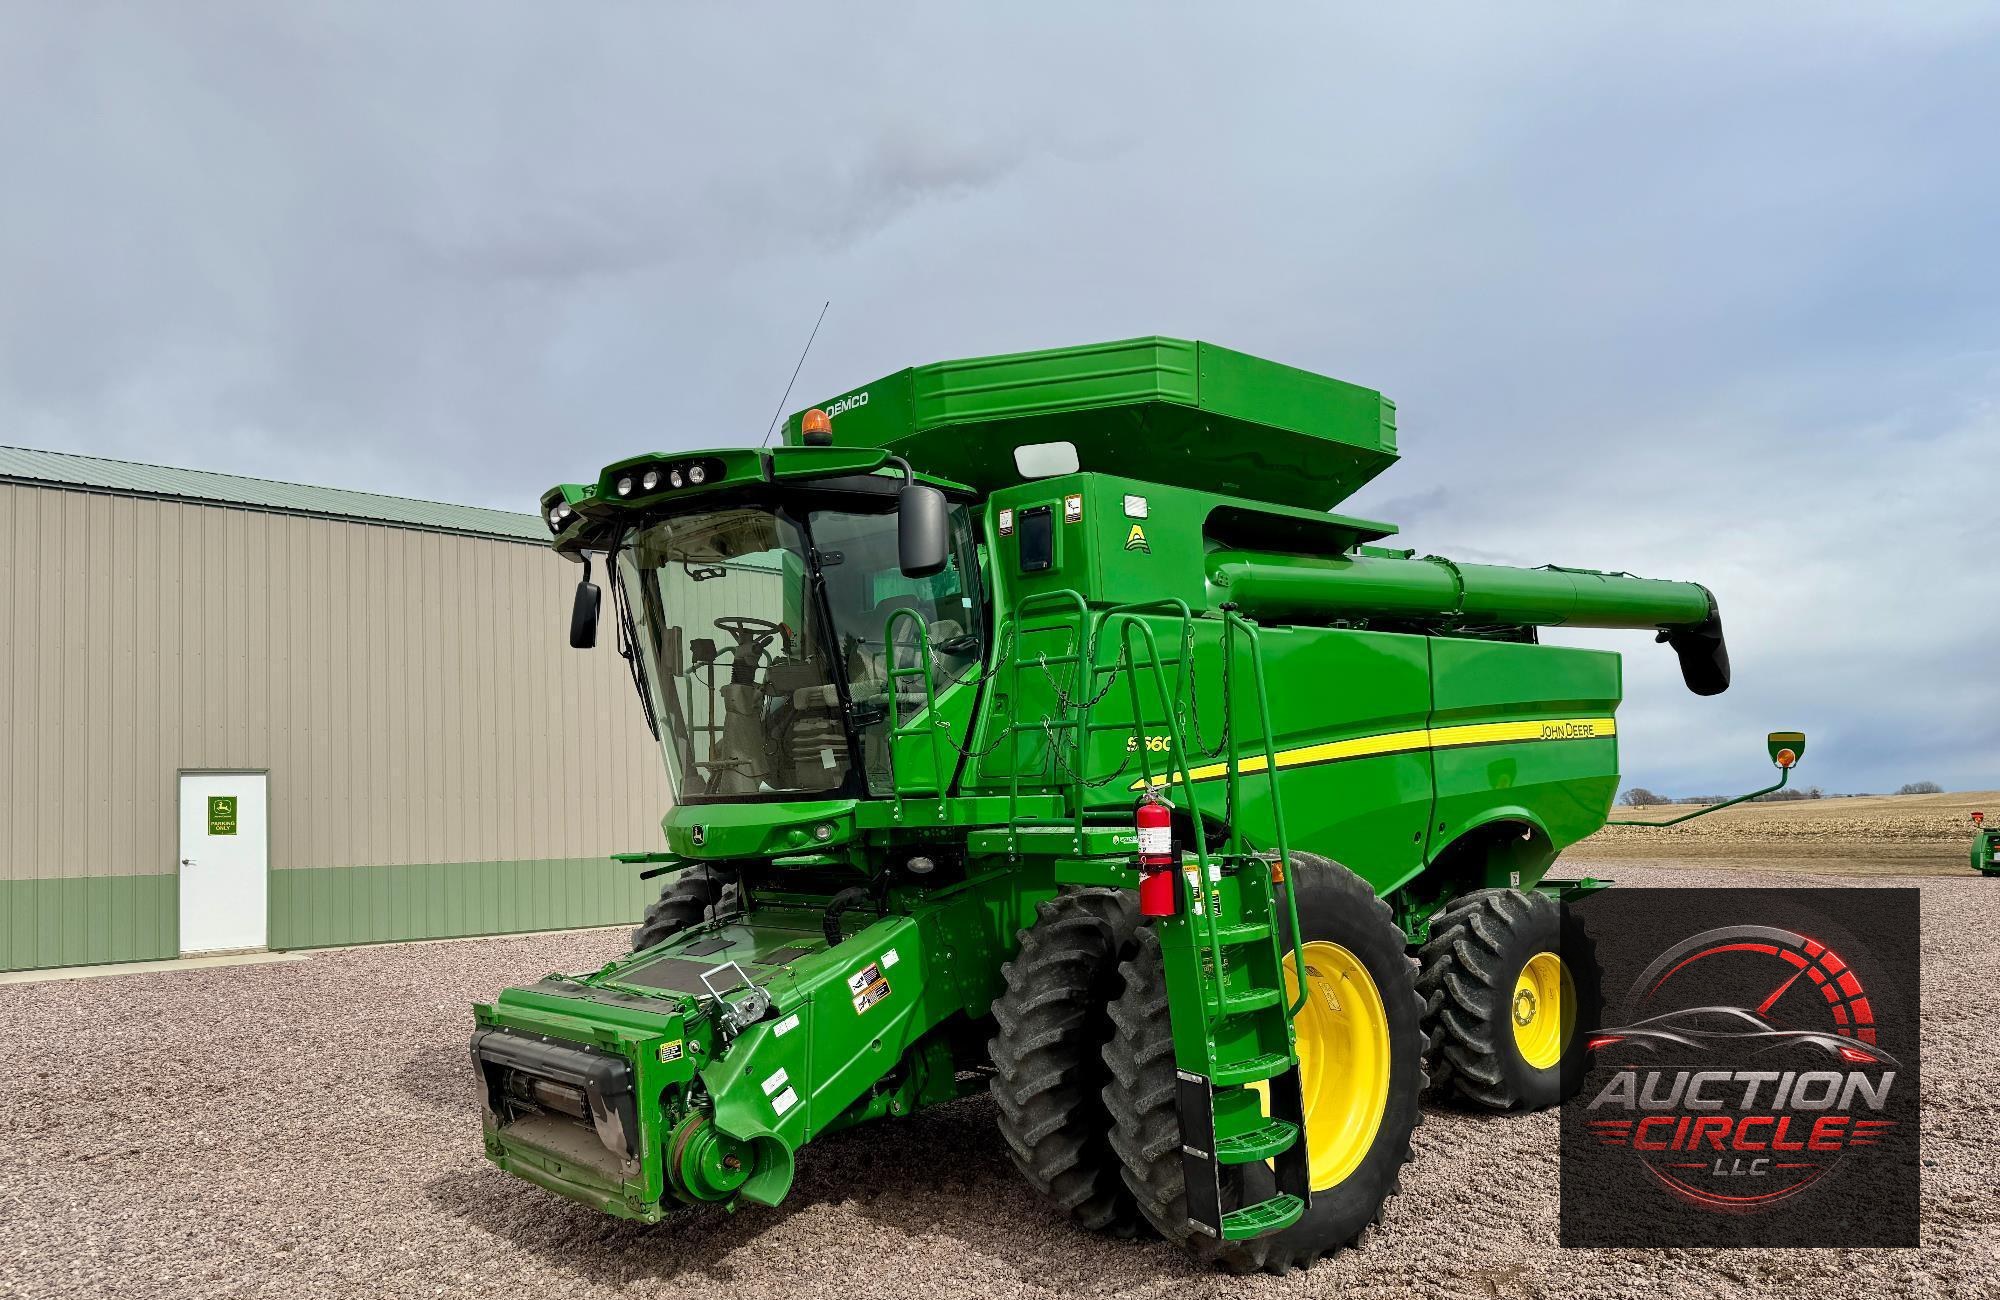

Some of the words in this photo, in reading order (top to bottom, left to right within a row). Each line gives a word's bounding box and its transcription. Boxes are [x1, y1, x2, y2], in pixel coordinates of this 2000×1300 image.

[826, 391, 869, 420] DEMCO
[1540, 723, 1565, 738] JOHN
[1565, 722, 1595, 737] DEERE
